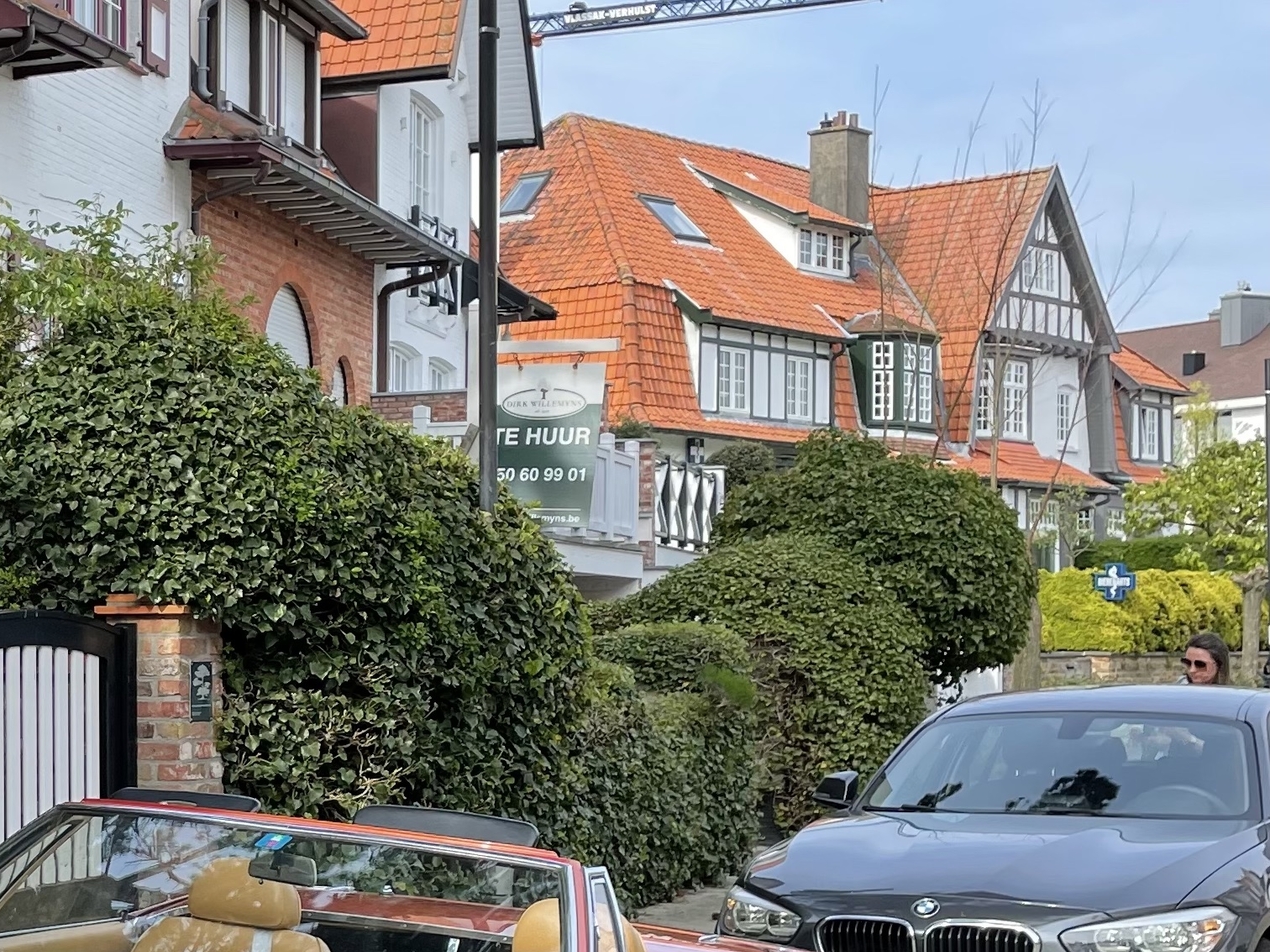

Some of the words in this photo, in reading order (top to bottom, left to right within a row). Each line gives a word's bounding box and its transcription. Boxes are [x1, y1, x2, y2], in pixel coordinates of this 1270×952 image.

[564, 4, 657, 23] VLASSAK-VERHULST
[507, 400, 528, 408] DIRK
[531, 400, 582, 408] WILLEMYNS
[497, 427, 520, 445] TE
[525, 427, 590, 445] HUUR
[519, 467, 539, 482] 60
[543, 467, 563, 482] 99
[567, 467, 586, 482] 01
